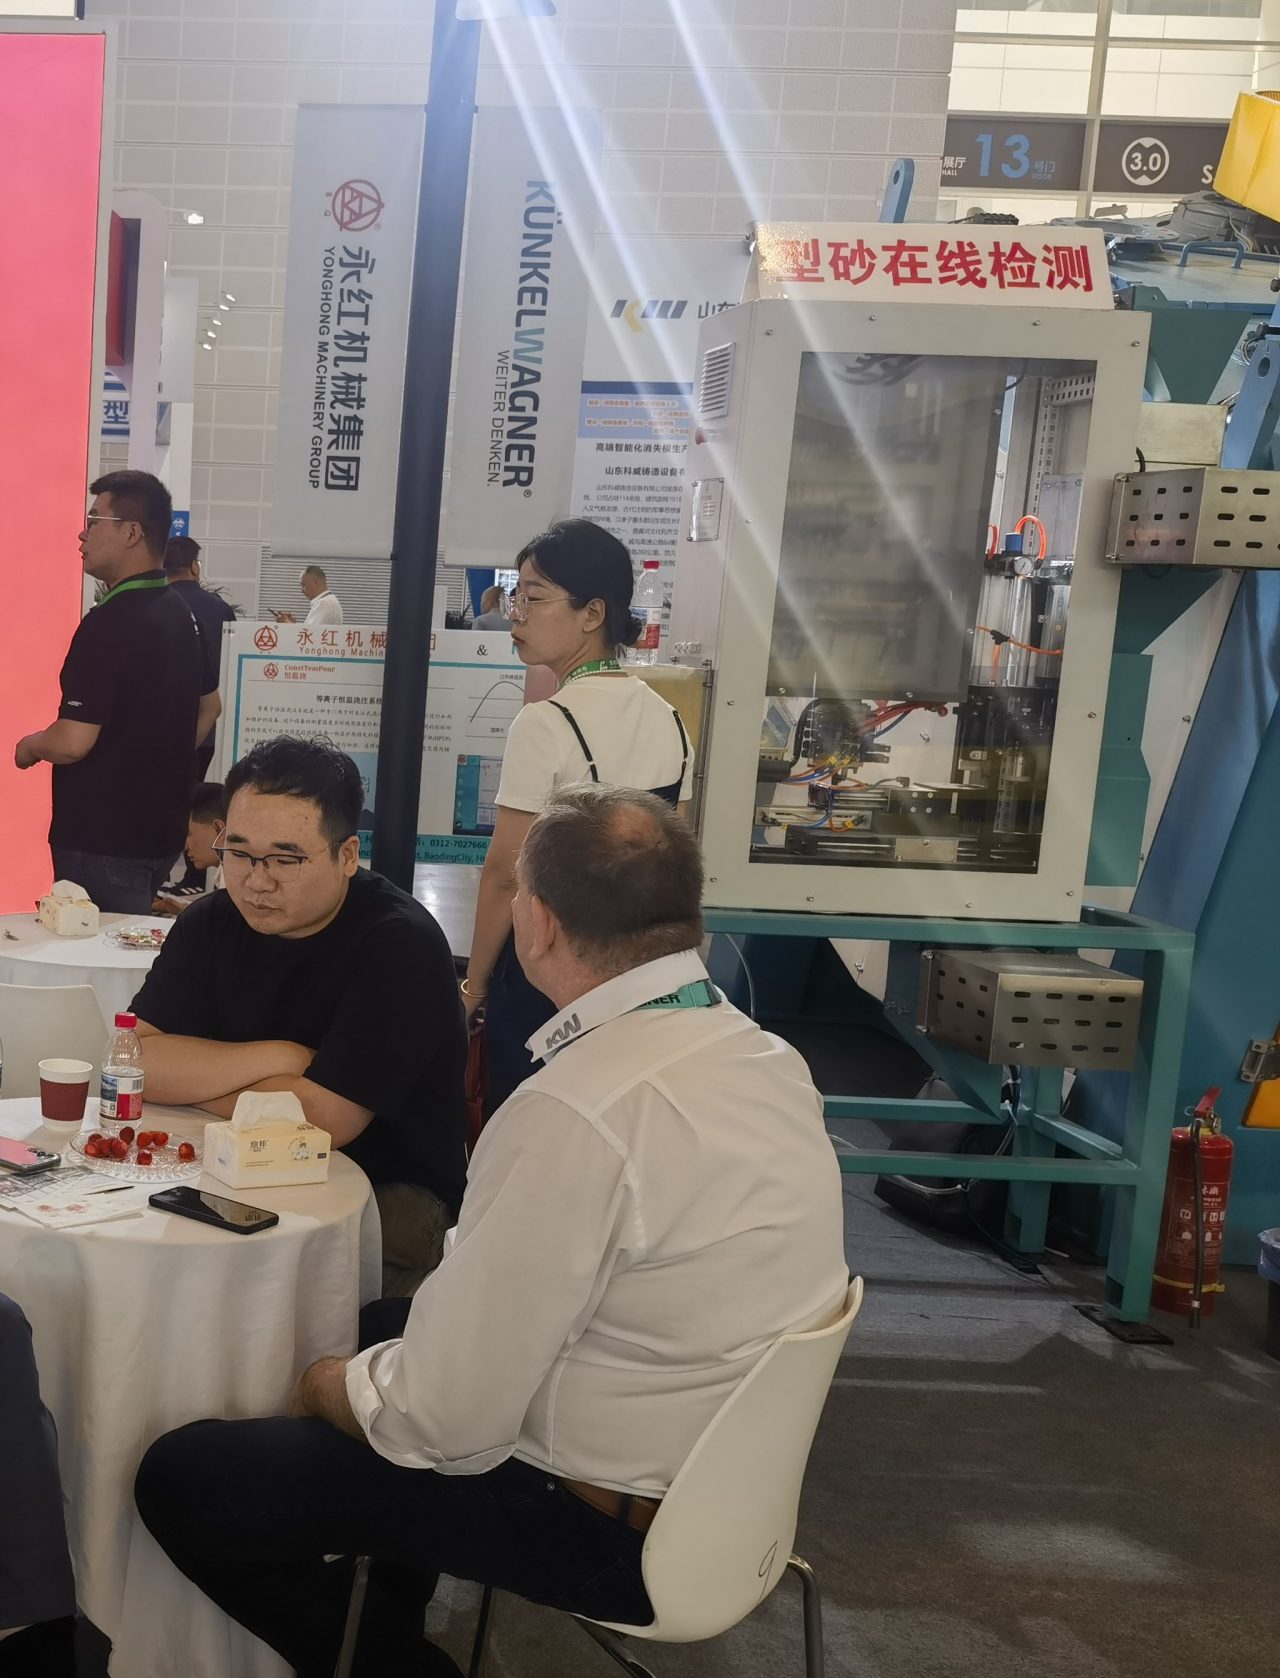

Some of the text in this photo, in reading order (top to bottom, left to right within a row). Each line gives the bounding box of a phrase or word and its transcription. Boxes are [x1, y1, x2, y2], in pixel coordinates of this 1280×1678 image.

[941, 156, 967, 169] 展厅
[975, 133, 1031, 178] 13
[1129, 152, 1162, 172] 3.0
[1034, 160, 1056, 173] 号门
[1200, 164, 1214, 185] S
[776, 238, 1095, 293] 型砂在线检测
[697, 301, 740, 319] 山东
[308, 246, 336, 490] YONGHONG MACHINERY GROUP
[324, 245, 377, 492] 永红机械集团
[103, 401, 129, 424] 型
[487, 350, 510, 487] WEITER DENKEN.
[299, 646, 385, 658] Yonghong Machin
[476, 644, 488, 656] &
[284, 664, 337, 673] ConstTemPour
[639, 993, 681, 1008] NER
[545, 1012, 582, 1050] KW
